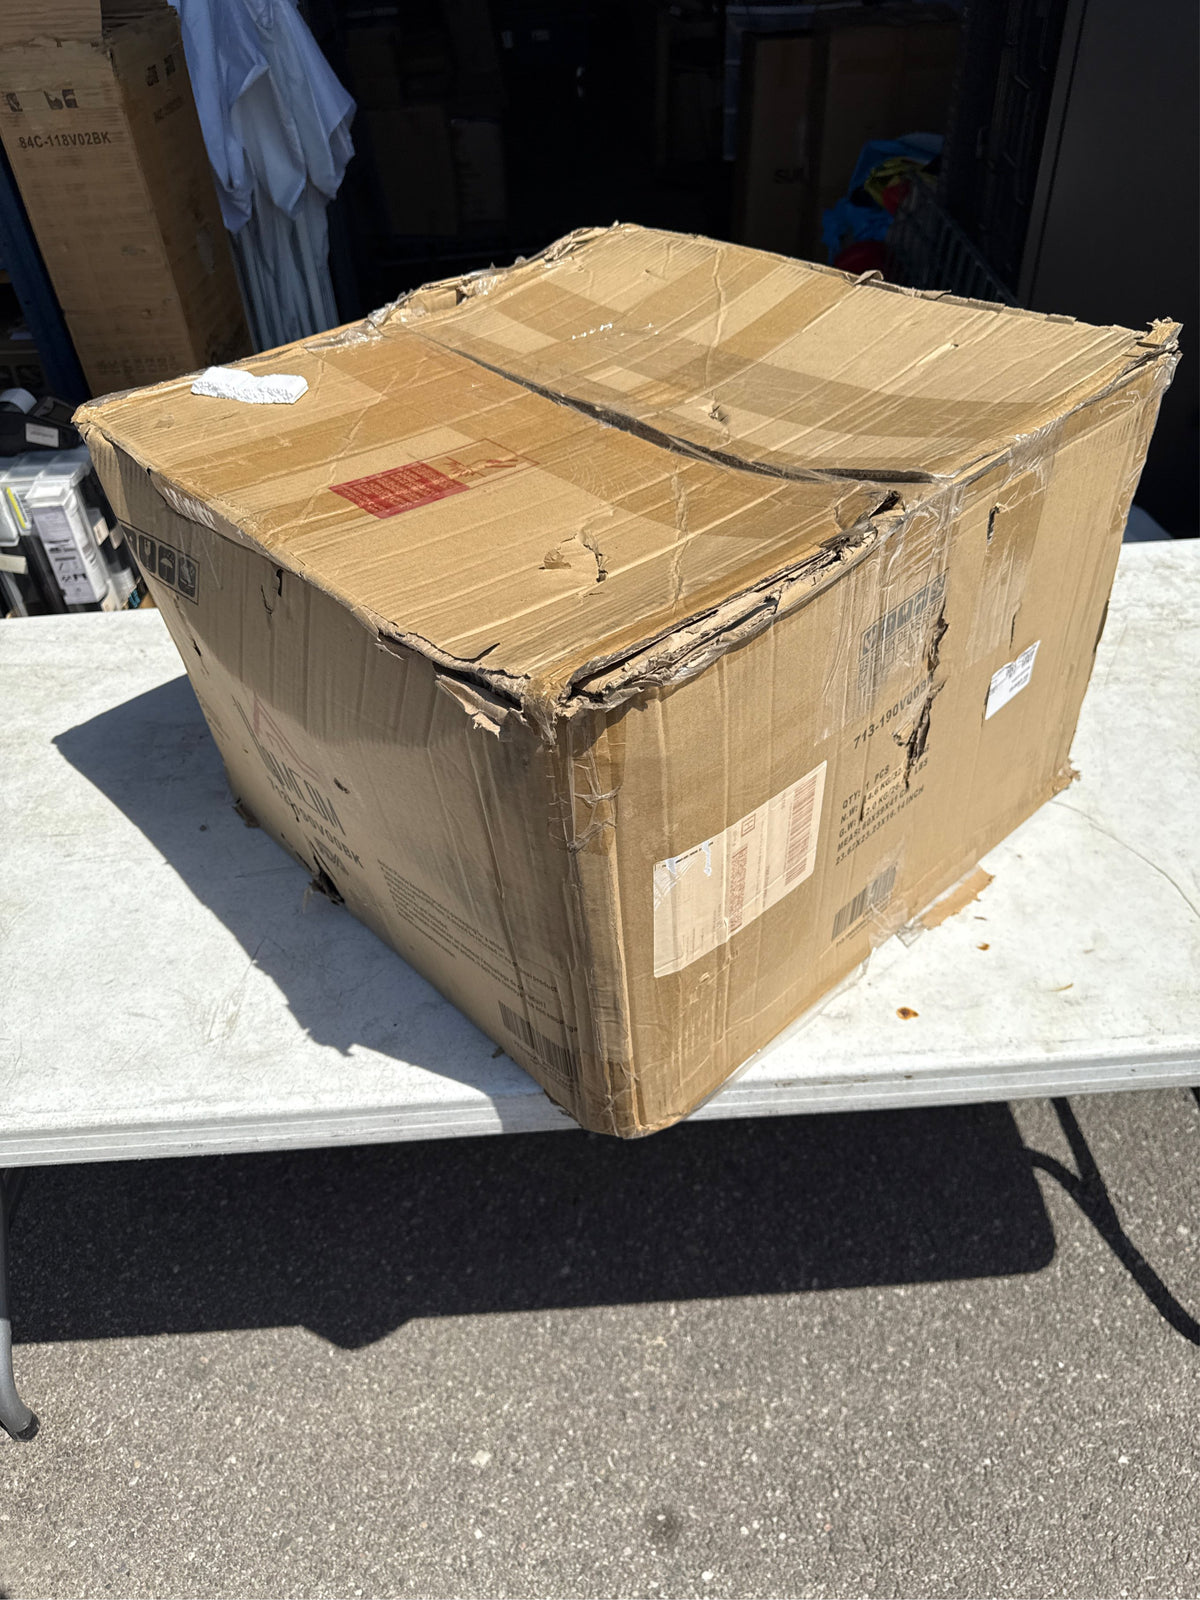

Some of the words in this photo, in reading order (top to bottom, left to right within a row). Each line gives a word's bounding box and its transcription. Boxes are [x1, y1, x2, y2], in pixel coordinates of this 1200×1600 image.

[18, 131, 112, 149] 84C-118V02BK
[842, 790, 861, 809] QTY:
[874, 764, 889, 784] PCS
